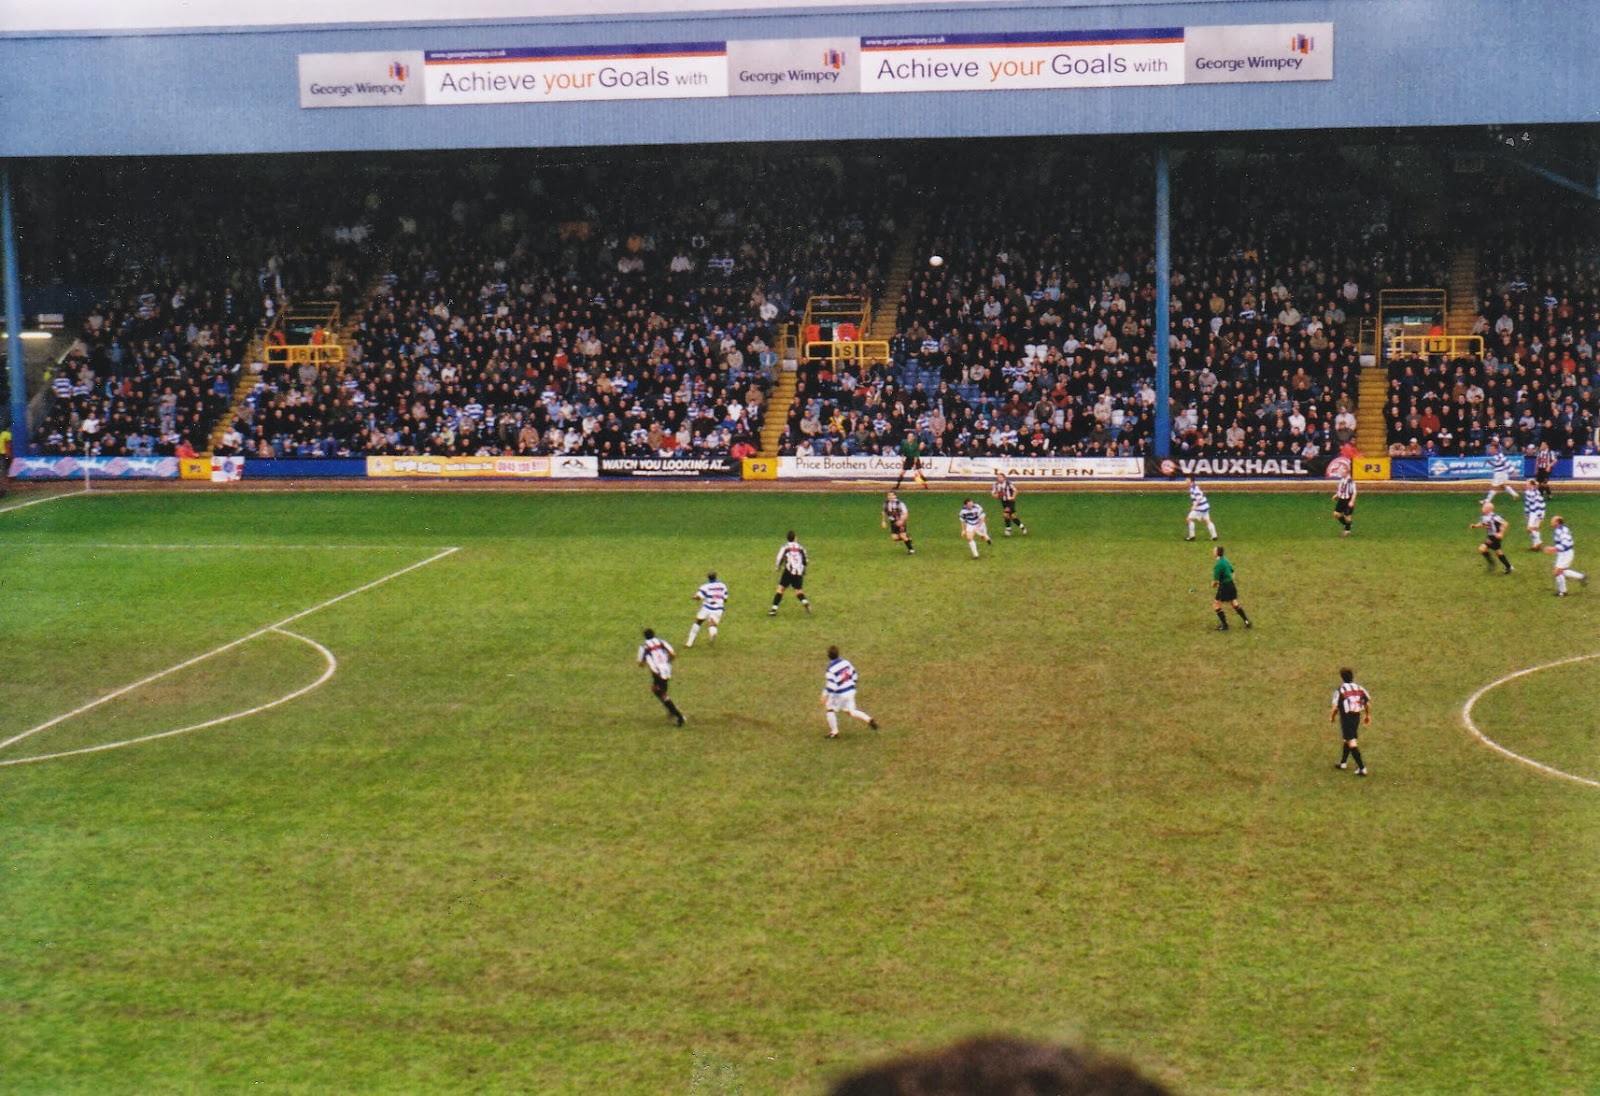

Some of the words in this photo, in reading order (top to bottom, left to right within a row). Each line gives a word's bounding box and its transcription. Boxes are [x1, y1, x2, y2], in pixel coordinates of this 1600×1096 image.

[877, 58, 979, 79] Achieve
[989, 60, 1046, 83] your
[1051, 53, 1127, 75] Goals
[1134, 58, 1168, 72] with
[1195, 57, 1245, 72] George
[1247, 56, 1303, 70] Wimpey
[440, 71, 536, 92] Achieve
[543, 71, 595, 95] your
[598, 66, 669, 88] Goals
[675, 72, 708, 86] with
[739, 70, 785, 84] George
[788, 69, 839, 83] Wimpey
[310, 83, 353, 97] George
[356, 82, 405, 95] Wimpey
[843, 345, 852, 356] S
[1434, 340, 1442, 350] T
[601, 459, 638, 470] WATCH
[639, 459, 661, 470] YOU
[662, 459, 709, 470] LOOKING
[752, 463, 767, 472] P2
[795, 457, 820, 470] Price
[823, 457, 868, 470] Brothers
[1179, 459, 1308, 474] VAUXHALL
[1364, 464, 1381, 473] P3
[993, 468, 1094, 476] LANTERN
